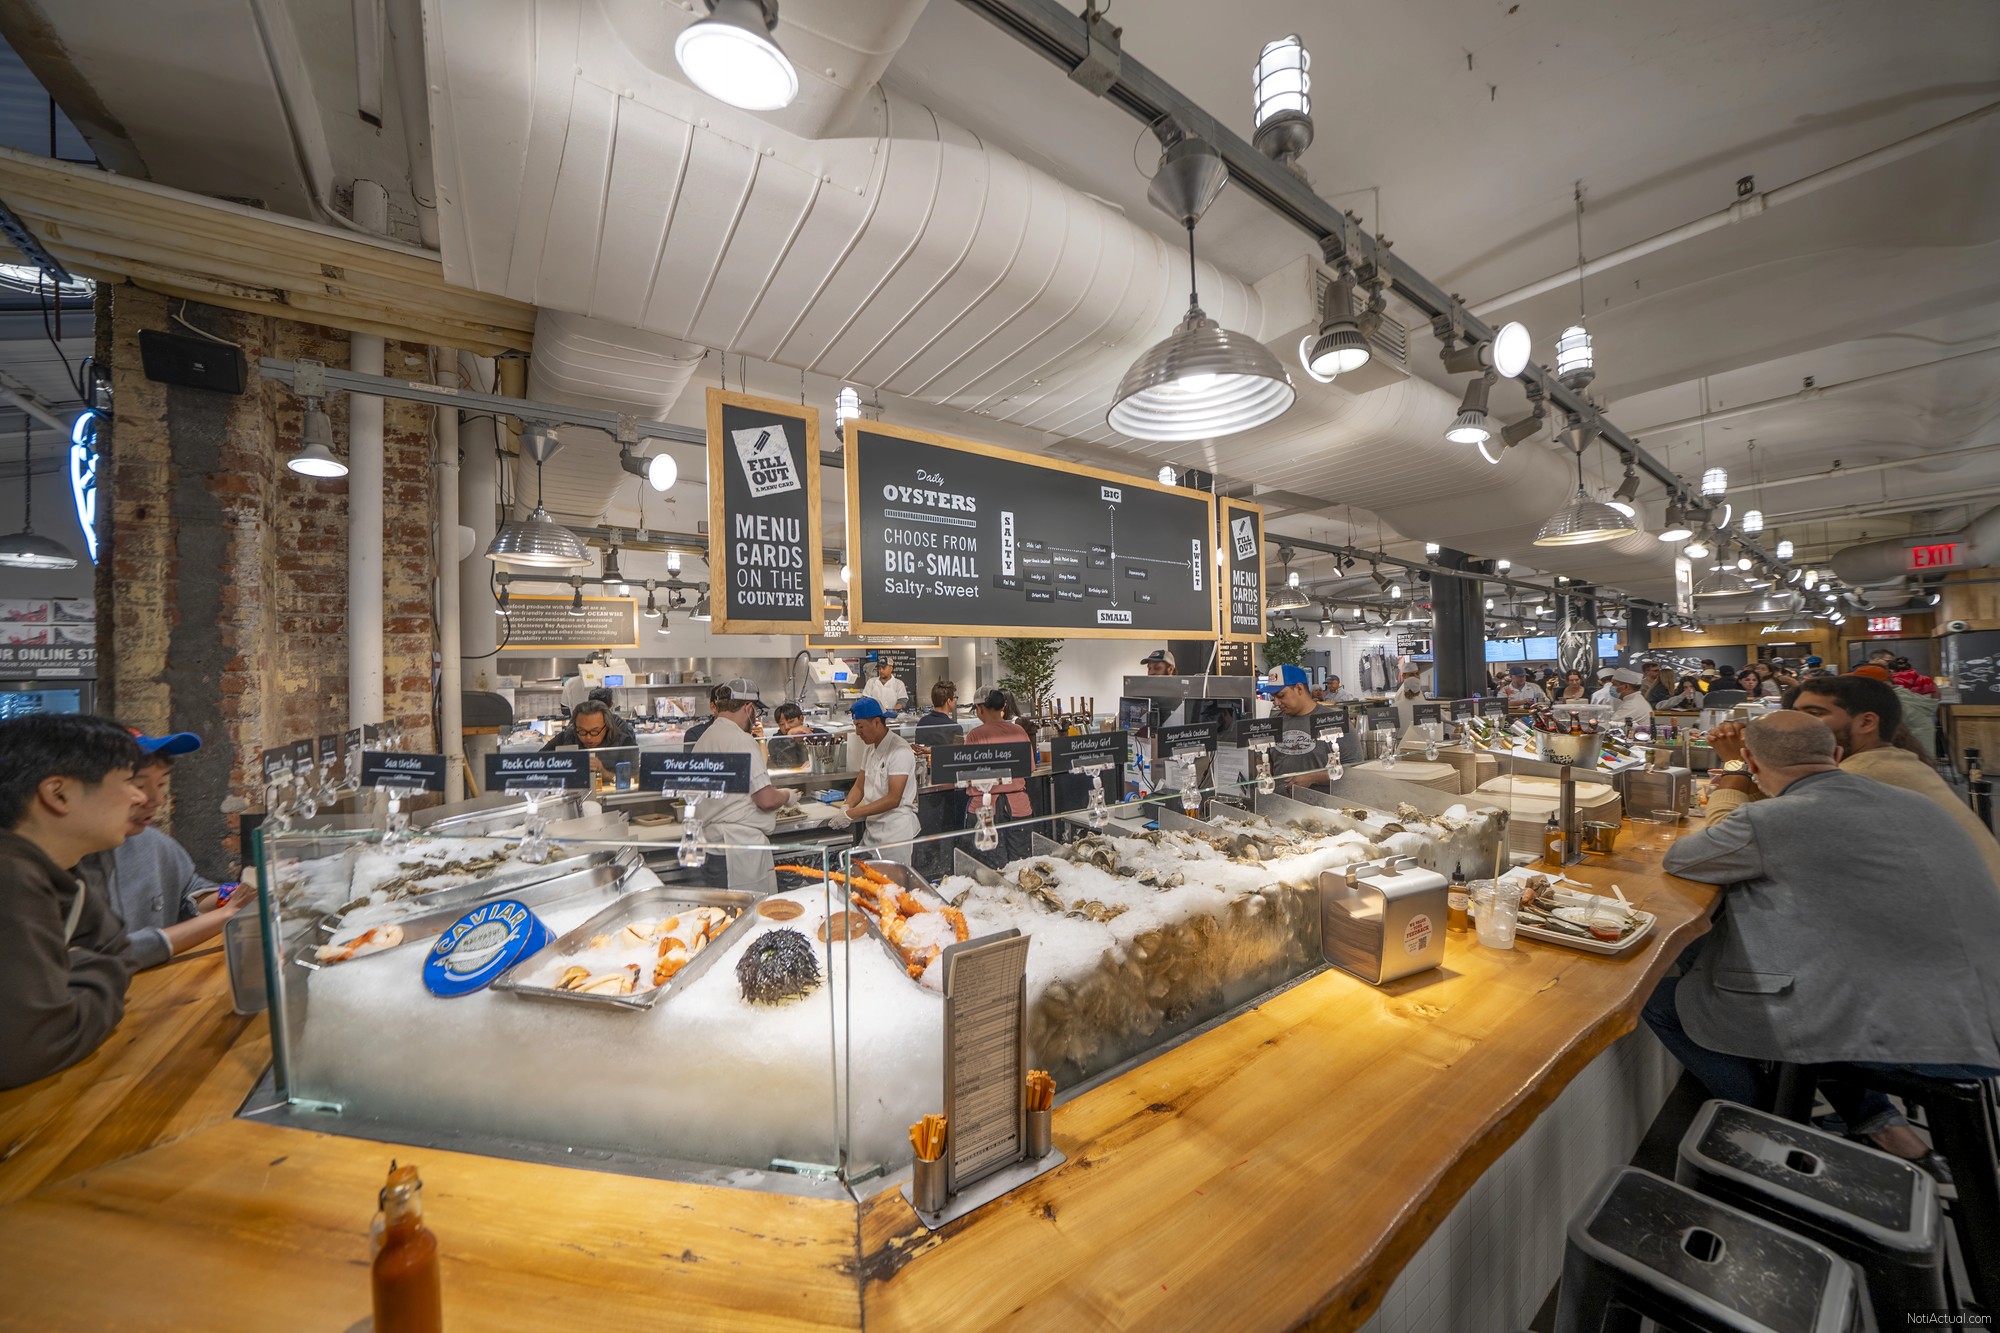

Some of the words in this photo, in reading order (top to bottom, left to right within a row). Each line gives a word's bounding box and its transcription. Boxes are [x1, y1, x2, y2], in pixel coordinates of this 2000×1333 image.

[747, 456, 787, 472] FILL
[752, 468, 789, 486] OUT
[916, 469, 945, 486] Daily
[883, 484, 977, 513] OYSTERS
[1103, 488, 1120, 501] BIG
[735, 513, 801, 544] MENU
[884, 528, 938, 548] CHOOSE
[943, 534, 977, 552] FROM
[1004, 516, 1013, 570] SALTY
[1237, 535, 1252, 545] FILL
[1239, 542, 1253, 554] OUT
[736, 542, 803, 569] CARDS
[885, 549, 915, 574] BIG
[926, 552, 979, 578] SMALL
[1912, 544, 1958, 568] EXIT
[1193, 543, 1201, 587] SWEET
[737, 568, 762, 588] ON
[770, 569, 804, 590] THE
[1232, 569, 1258, 588] MENU
[885, 578, 925, 598] Salty
[934, 580, 979, 598] Sweet
[1232, 586, 1258, 603] CARDS
[737, 589, 804, 608] COUNTER
[1100, 611, 1130, 622] SMALL
[1232, 602, 1243, 614] ON
[1244, 603, 1258, 616] THE
[1232, 615, 1259, 626] COUNTER
[18, 648, 74, 660] ONLINE
[1071, 738, 1099, 751] Birthday
[1099, 737, 1111, 748] Girl
[384, 757, 398, 769] Sea
[398, 758, 422, 770] Urchin
[502, 757, 524, 770] Rock
[524, 756, 545, 769] Crab
[546, 756, 573, 769] Claws
[953, 751, 972, 763] King
[973, 748, 993, 760] Crab
[994, 748, 1012, 760] Legs
[663, 758, 689, 770] Diver
[688, 758, 725, 772] Scallops
[435, 903, 528, 955] CAVIAR
[1406, 924, 1430, 939] FEEDBACK
